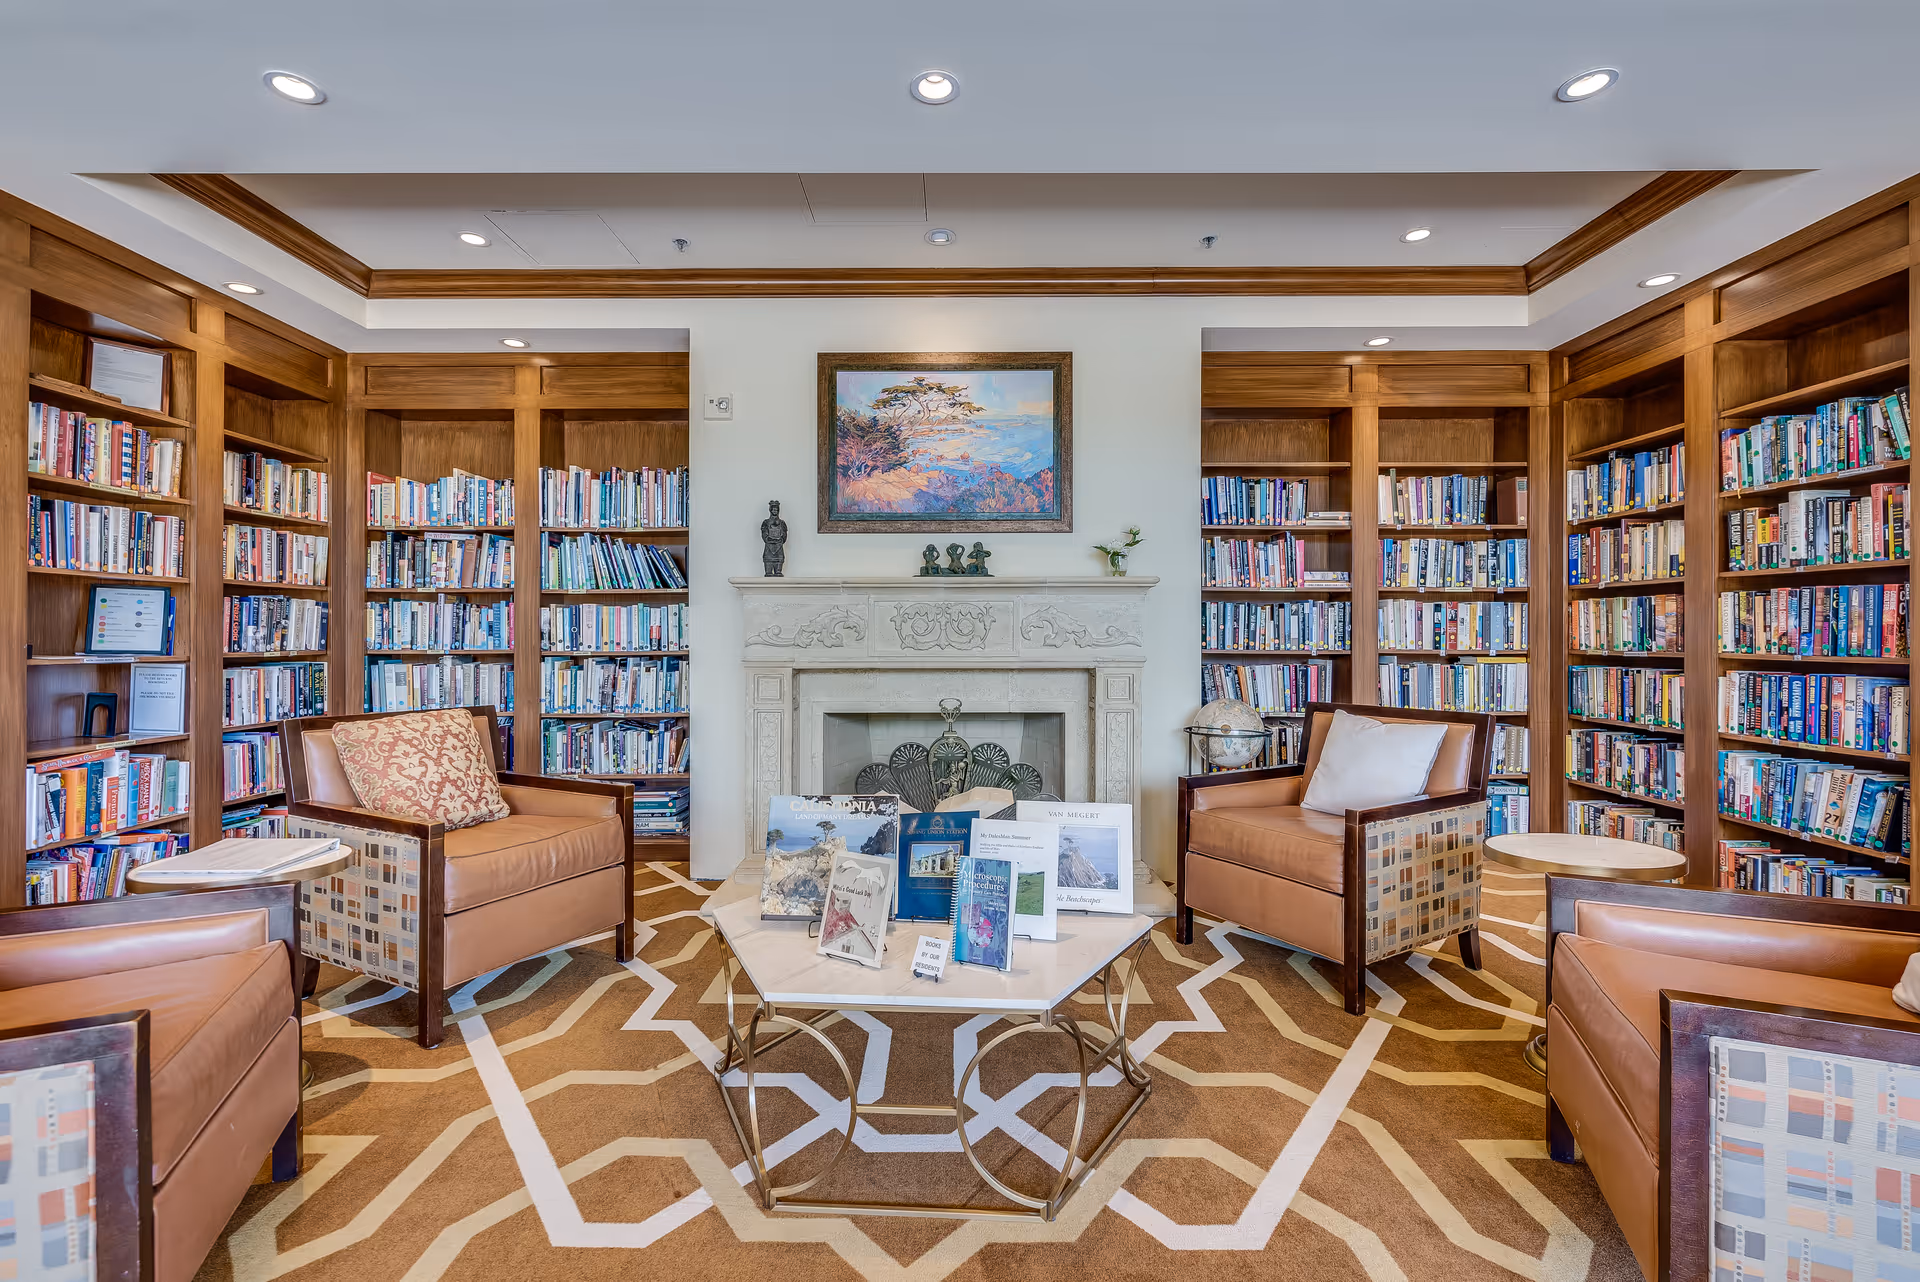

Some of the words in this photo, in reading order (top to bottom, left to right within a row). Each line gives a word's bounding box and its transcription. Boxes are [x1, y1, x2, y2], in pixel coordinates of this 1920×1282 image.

[1731, 513, 1740, 525] TOM
[1747, 511, 1755, 523] Tom
[1732, 526, 1741, 545] CLANCY
[1746, 524, 1757, 543] Clancy
[1801, 589, 1809, 609] PATRICIA
[1801, 610, 1809, 633] CORNWELL
[1792, 681, 1801, 695] CLIVE
[1792, 695, 1801, 717] CUSSLER
[1836, 774, 1848, 801] WILLIAM
[1847, 784, 1859, 813] TANGLED
[790, 800, 877, 812] CALIFORNIA
[1510, 798, 1518, 816] FDR
[51, 812, 59, 827] WORD
[1824, 813, 1839, 825] 27
[1843, 817, 1852, 835] VINES
[964, 870, 1008, 882] Microscopic
[846, 886, 855, 894] Good
[963, 880, 1004, 892] Procedures
[1066, 895, 1100, 905] Beachscapes
[925, 941, 941, 949] BOOKS
[915, 962, 940, 972] RESIDENTS
